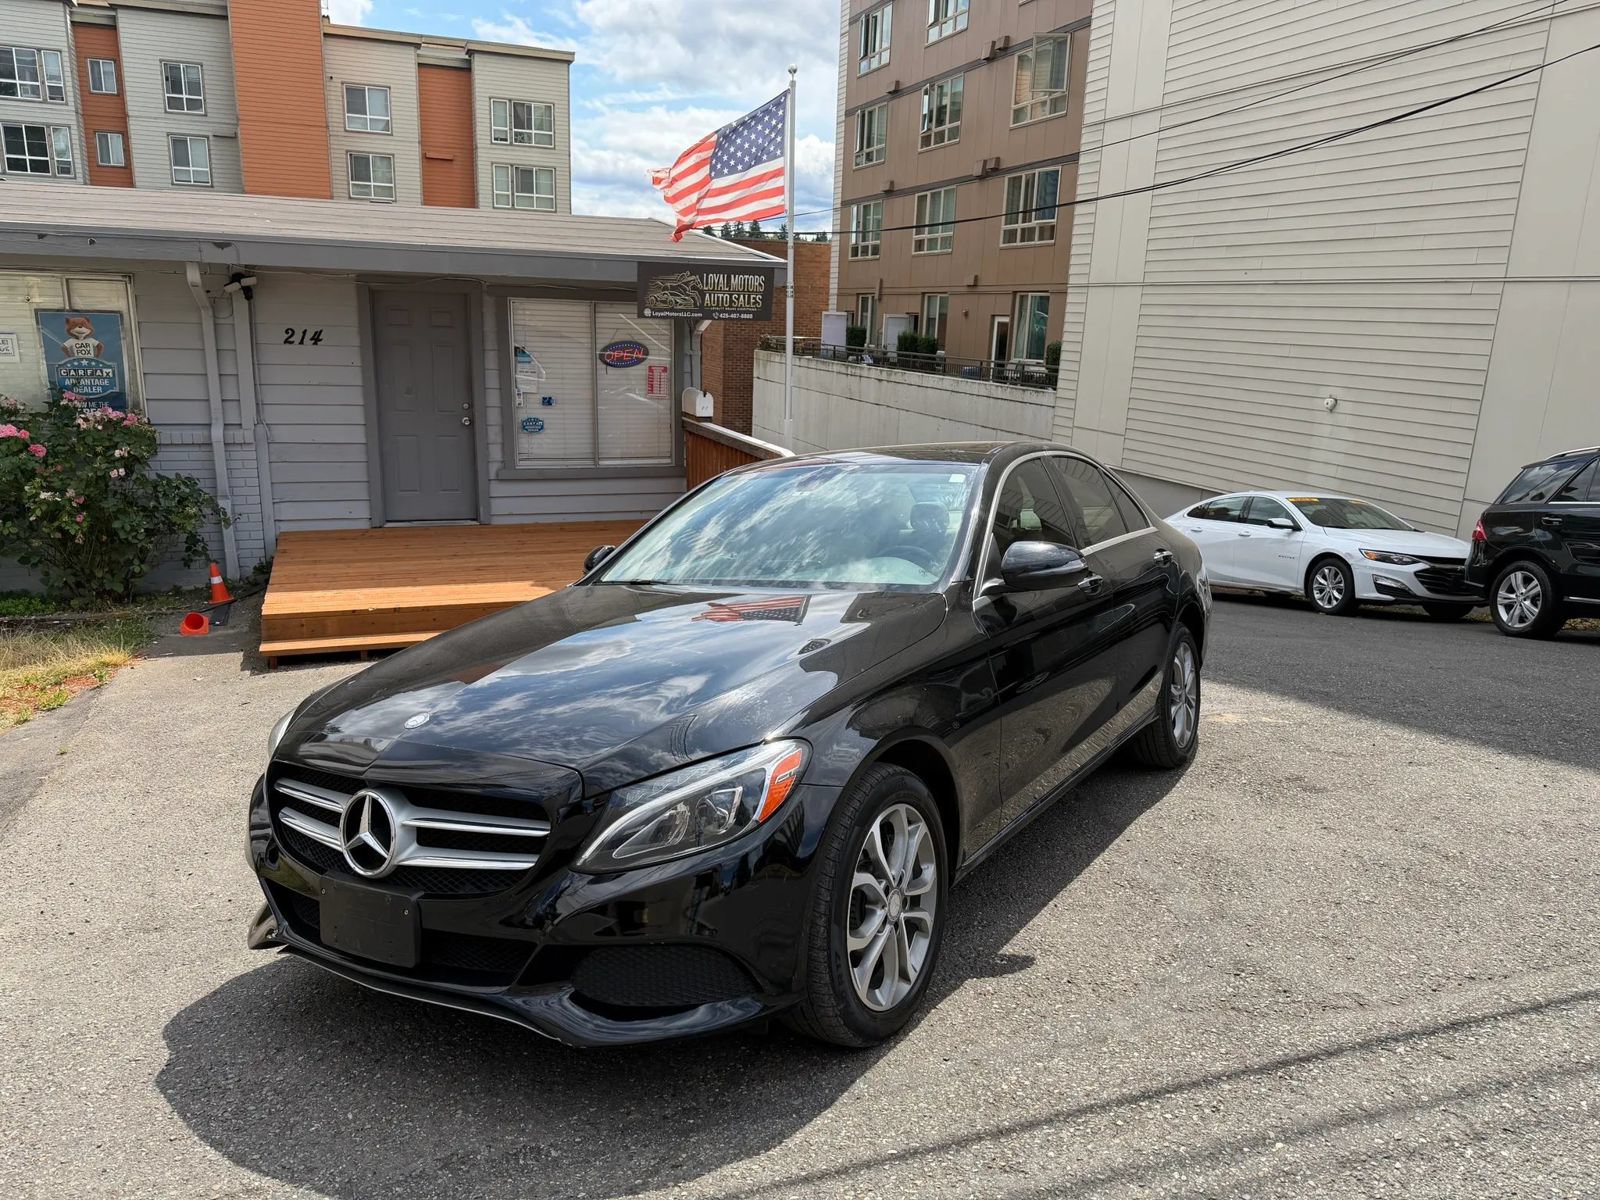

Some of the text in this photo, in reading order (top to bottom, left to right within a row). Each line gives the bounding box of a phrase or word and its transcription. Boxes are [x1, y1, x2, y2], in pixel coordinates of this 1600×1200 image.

[703, 273, 765, 292] LOYAL MOTORS
[704, 293, 762, 308] AUTO SALES
[283, 327, 324, 346] 214
[604, 348, 644, 362] OPEN
[60, 368, 112, 377] CARFAX
[64, 378, 110, 386] ADANTAGE
